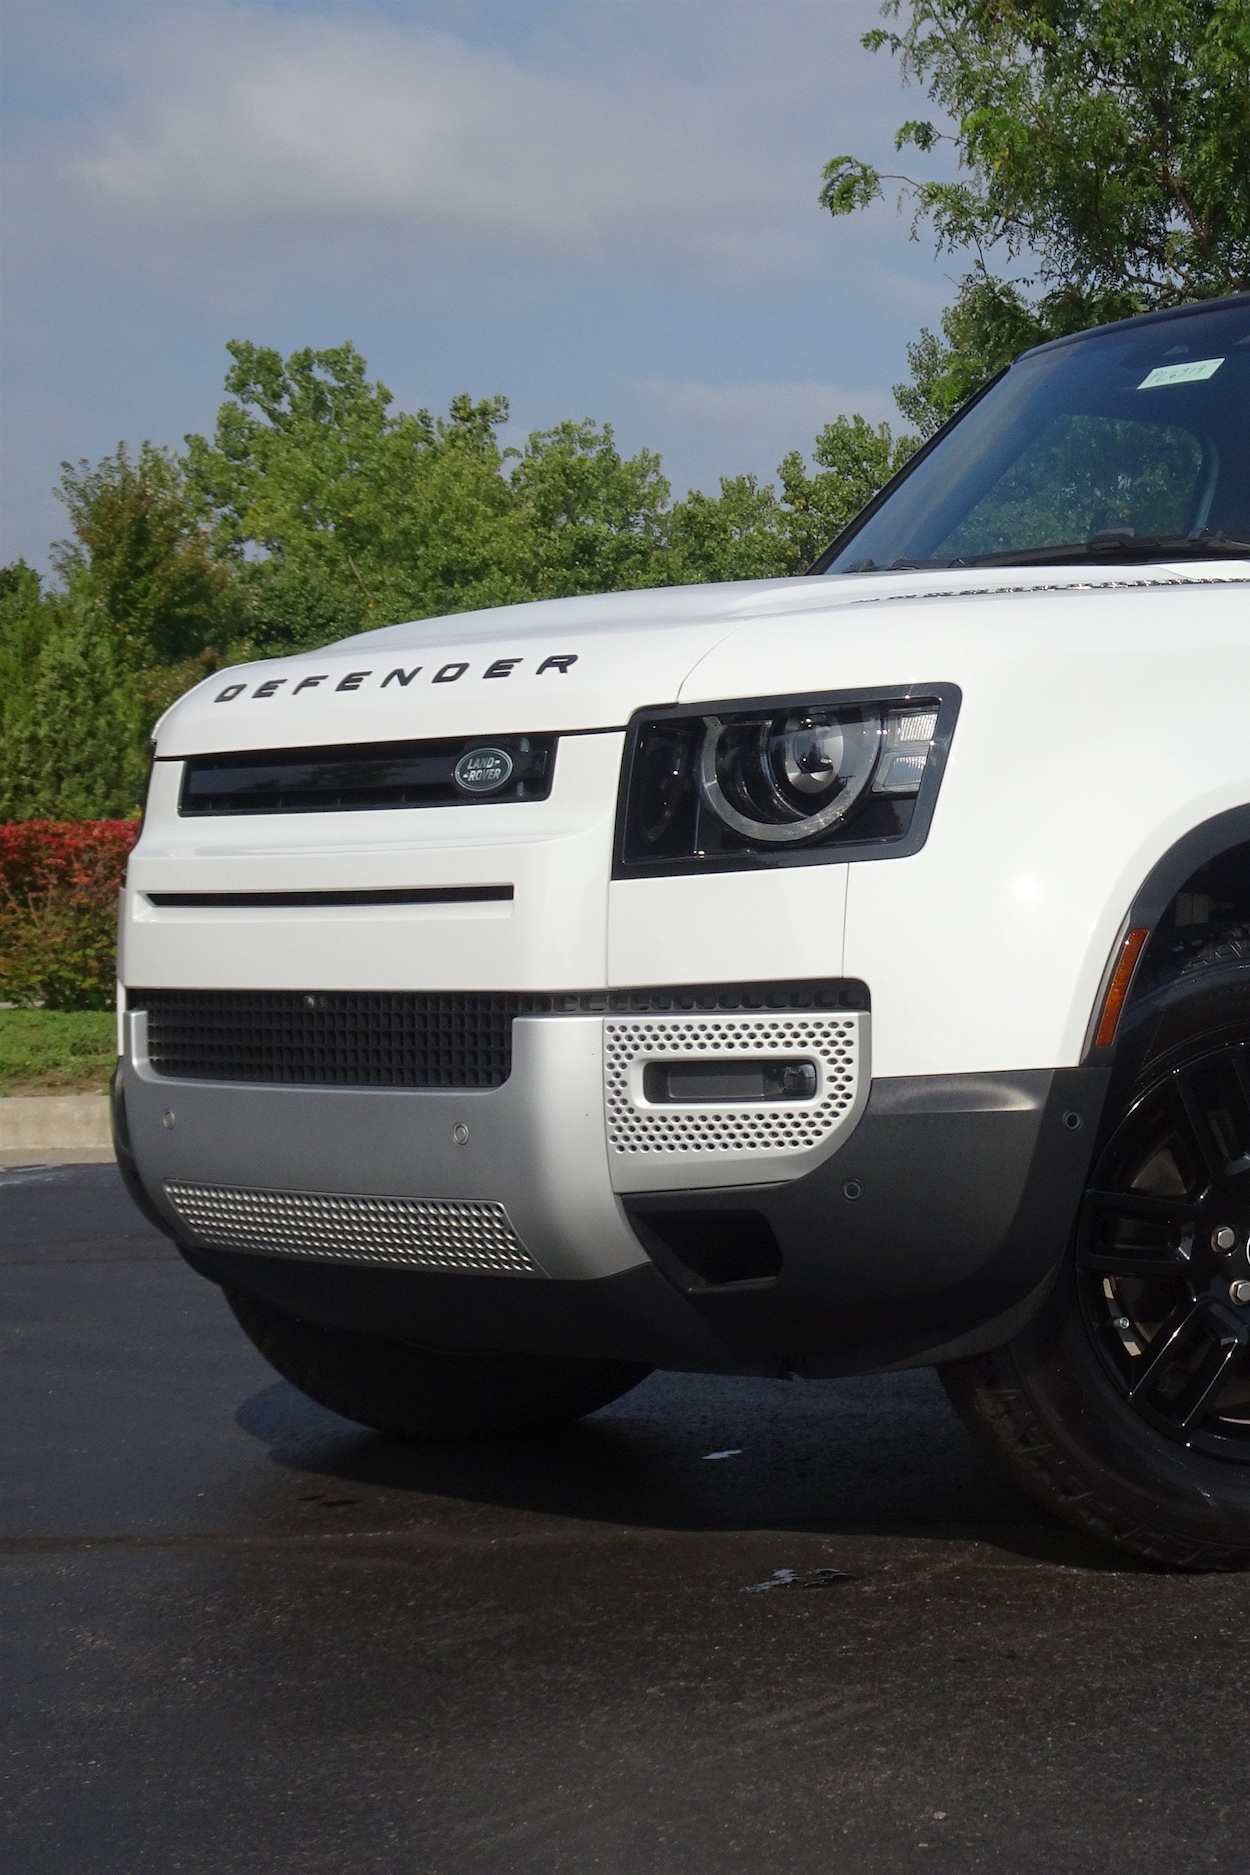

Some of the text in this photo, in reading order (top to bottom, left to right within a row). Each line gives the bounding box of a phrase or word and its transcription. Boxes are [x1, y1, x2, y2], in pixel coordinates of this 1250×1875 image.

[213, 654, 578, 703] DEFENDER
[467, 756, 495, 770] LAND
[468, 768, 501, 781] ROVER
